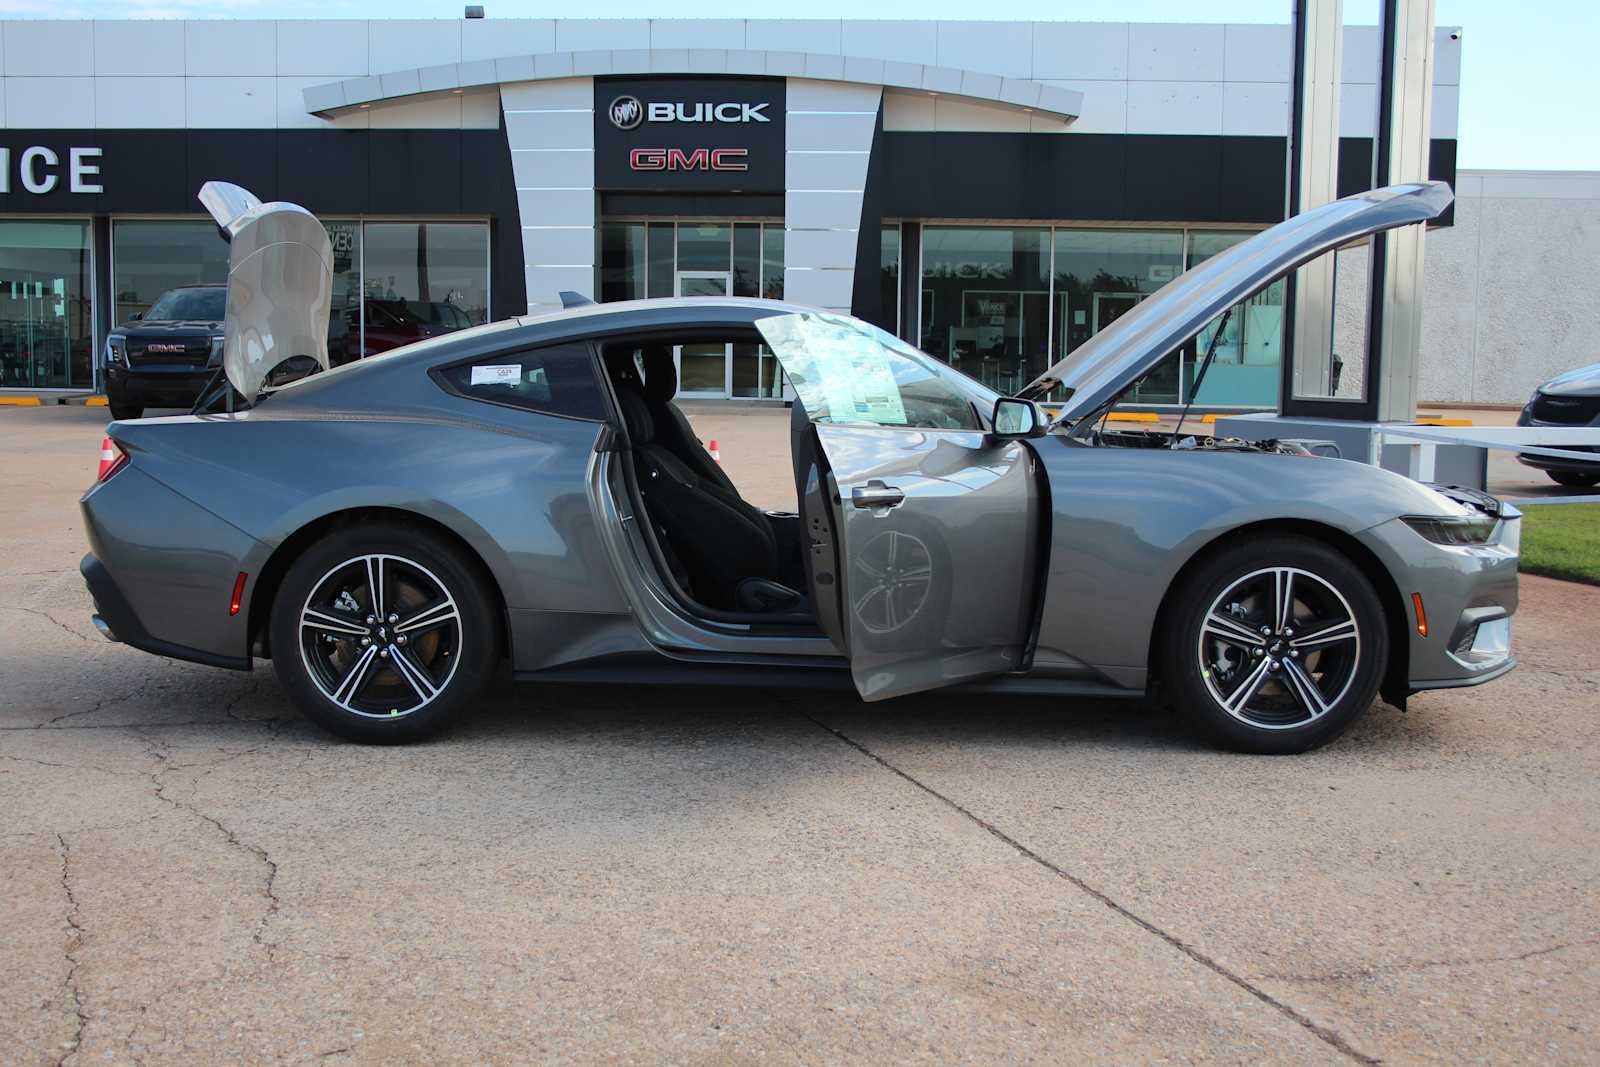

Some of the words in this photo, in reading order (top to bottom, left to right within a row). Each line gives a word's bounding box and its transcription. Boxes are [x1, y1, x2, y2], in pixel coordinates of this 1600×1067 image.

[647, 102, 771, 123] BUICK
[0, 146, 104, 194] ICE
[629, 148, 749, 171] GMC
[889, 261, 1008, 279] UICK
[147, 343, 185, 353] GMC
